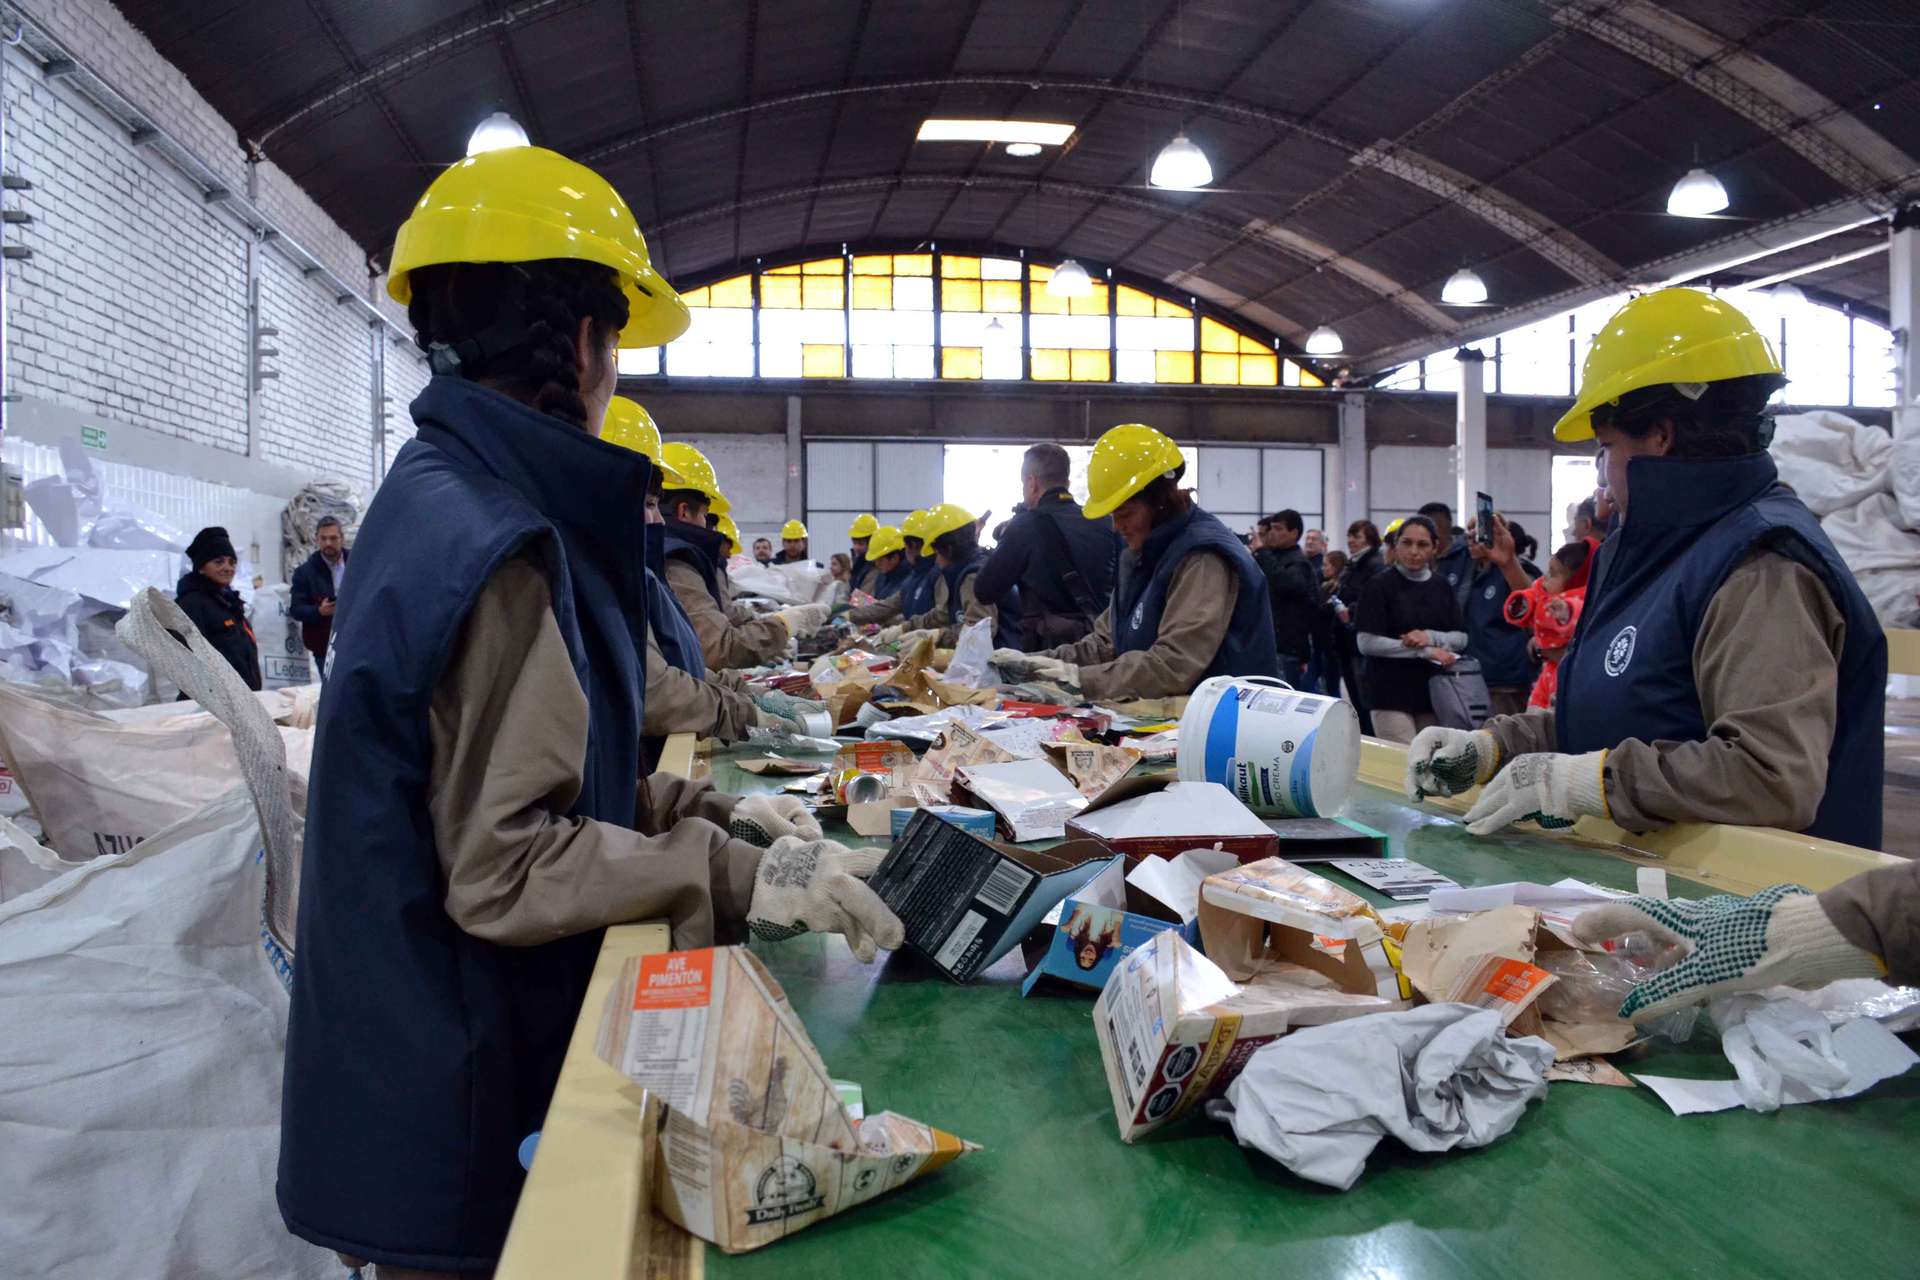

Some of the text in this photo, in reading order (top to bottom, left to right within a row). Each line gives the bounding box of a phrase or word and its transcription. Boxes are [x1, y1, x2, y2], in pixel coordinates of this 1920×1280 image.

[1237, 762, 1252, 804] Milkaut
[1272, 756, 1282, 792] CREMA
[666, 957, 687, 972] AVE
